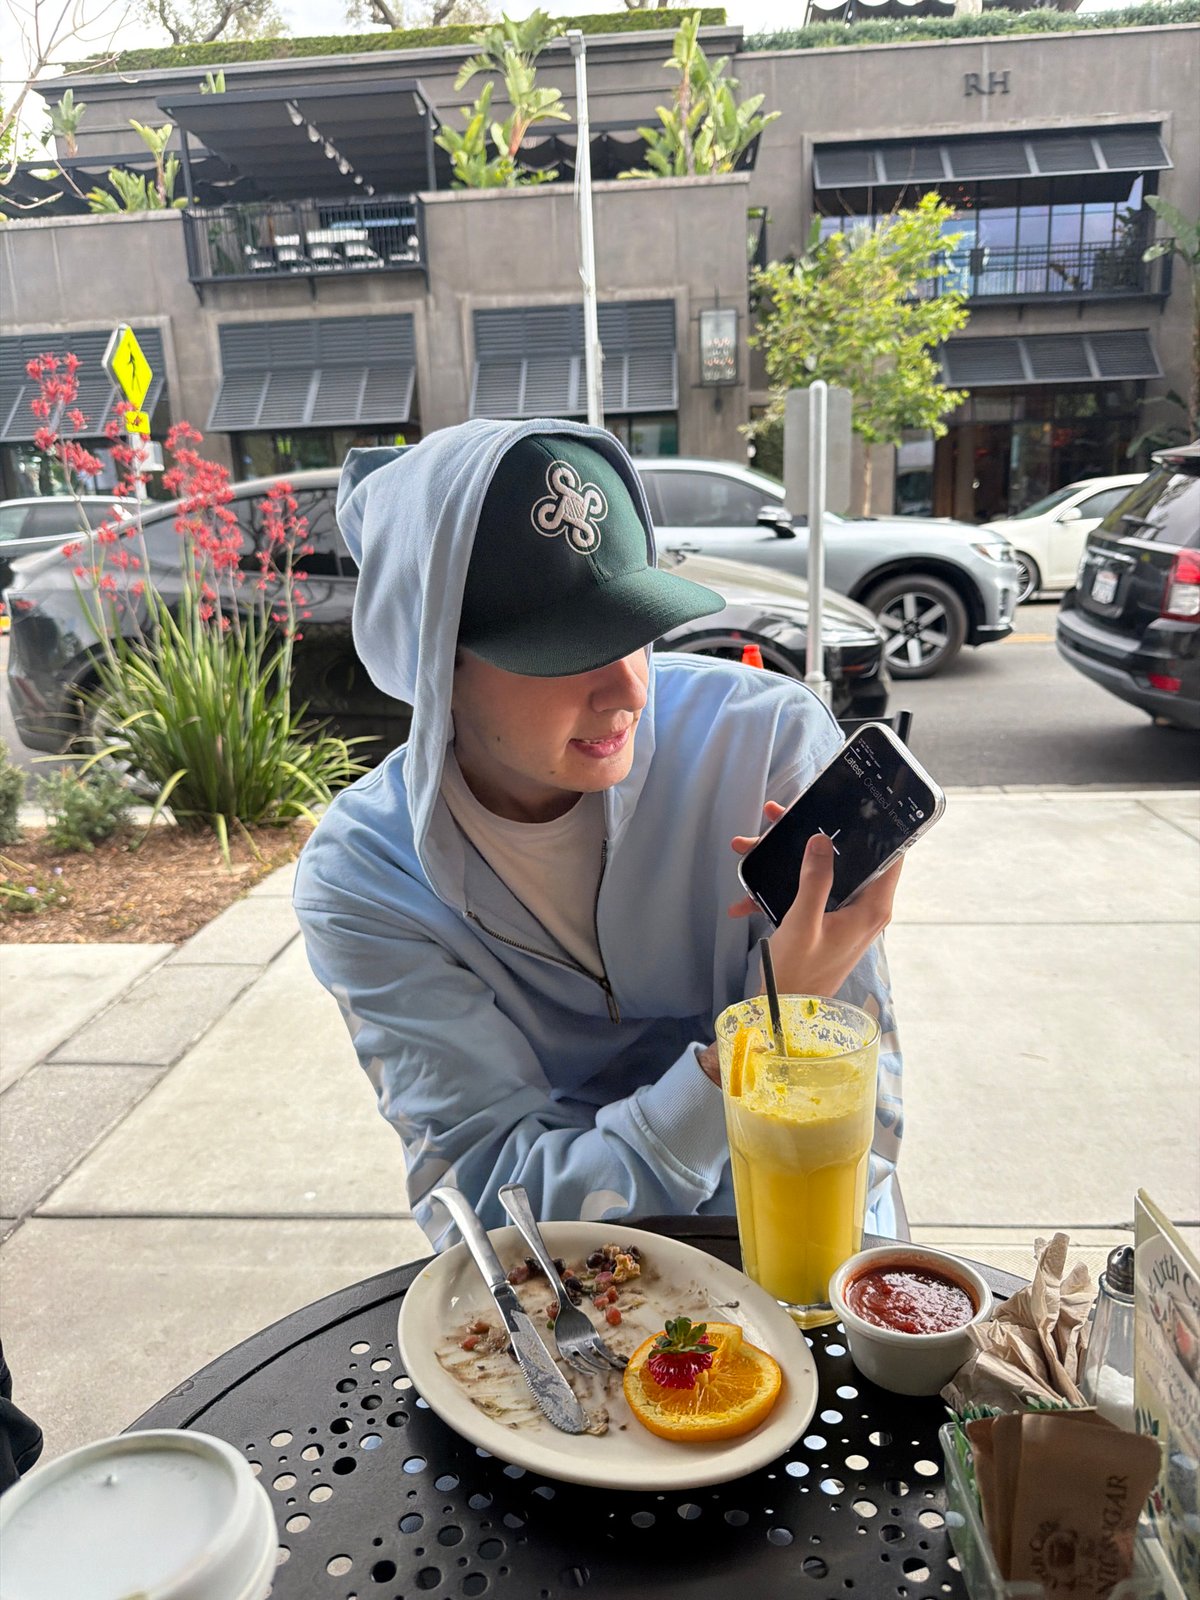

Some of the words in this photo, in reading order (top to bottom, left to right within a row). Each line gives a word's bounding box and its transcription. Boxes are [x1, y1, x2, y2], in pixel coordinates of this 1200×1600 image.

[964, 71, 1011, 96] RH
[843, 751, 865, 778] Latest
[863, 777, 891, 810] Created
